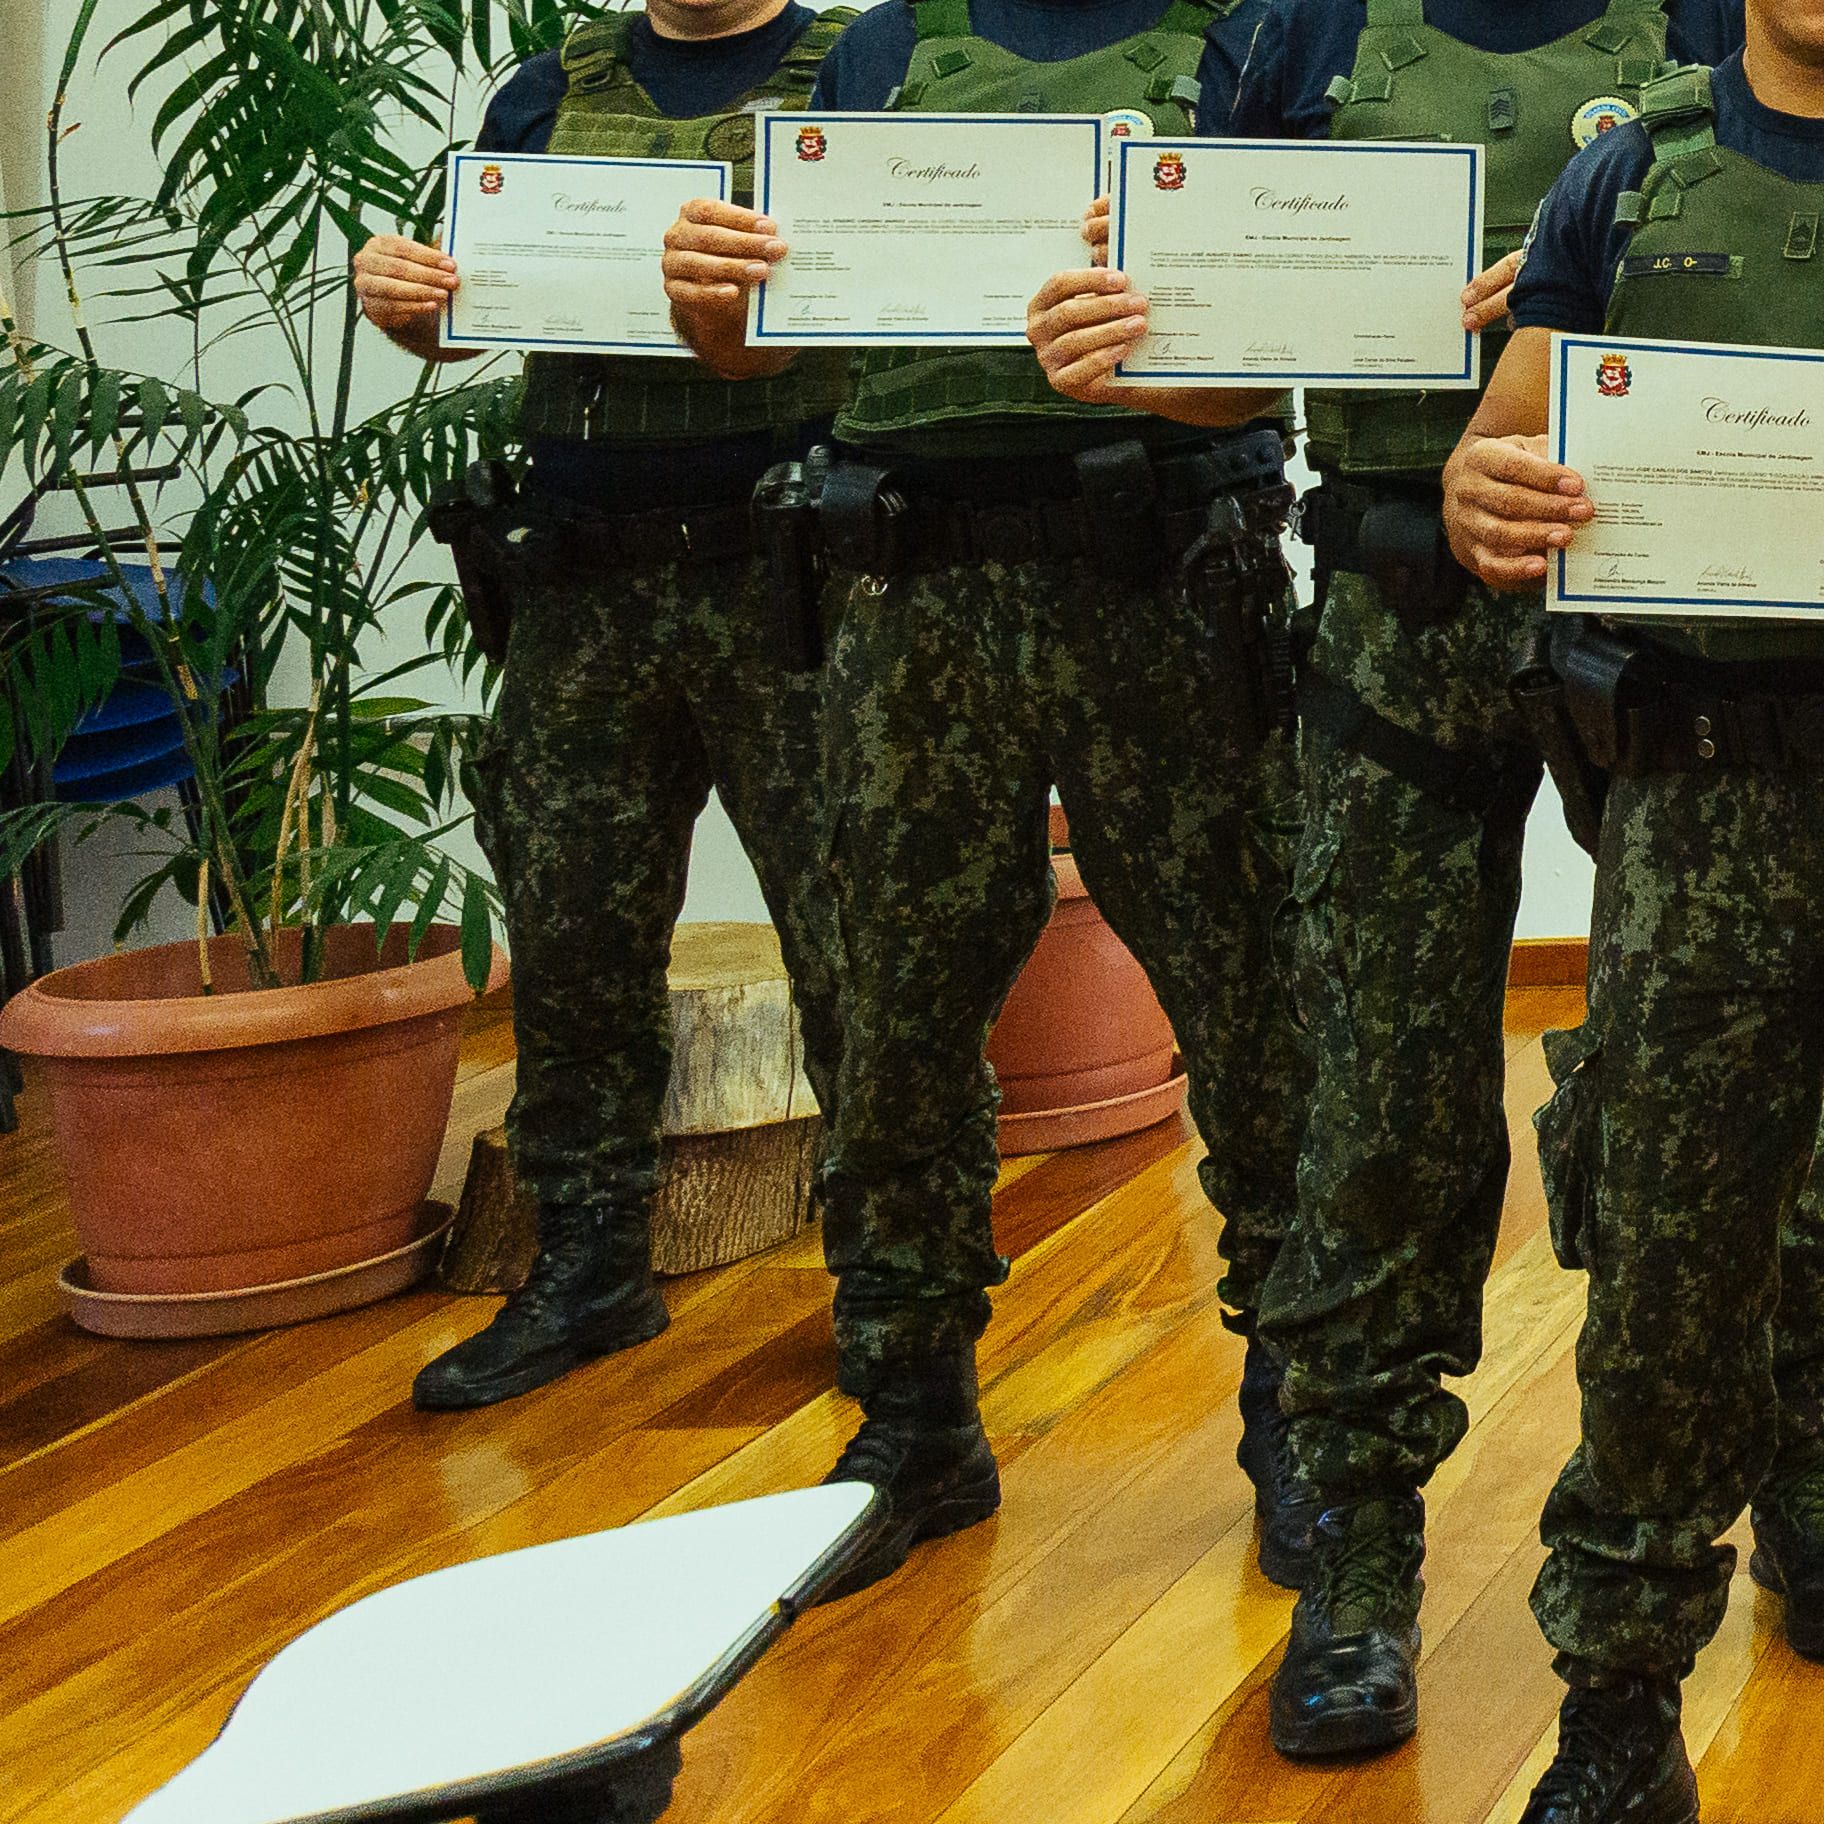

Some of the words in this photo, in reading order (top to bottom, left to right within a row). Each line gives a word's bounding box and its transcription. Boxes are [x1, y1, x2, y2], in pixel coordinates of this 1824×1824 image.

[887, 156, 981, 185] Certificado
[551, 192, 627, 217] Certificado
[1249, 186, 1350, 217] Certificado
[1700, 396, 1812, 432] Certificado
